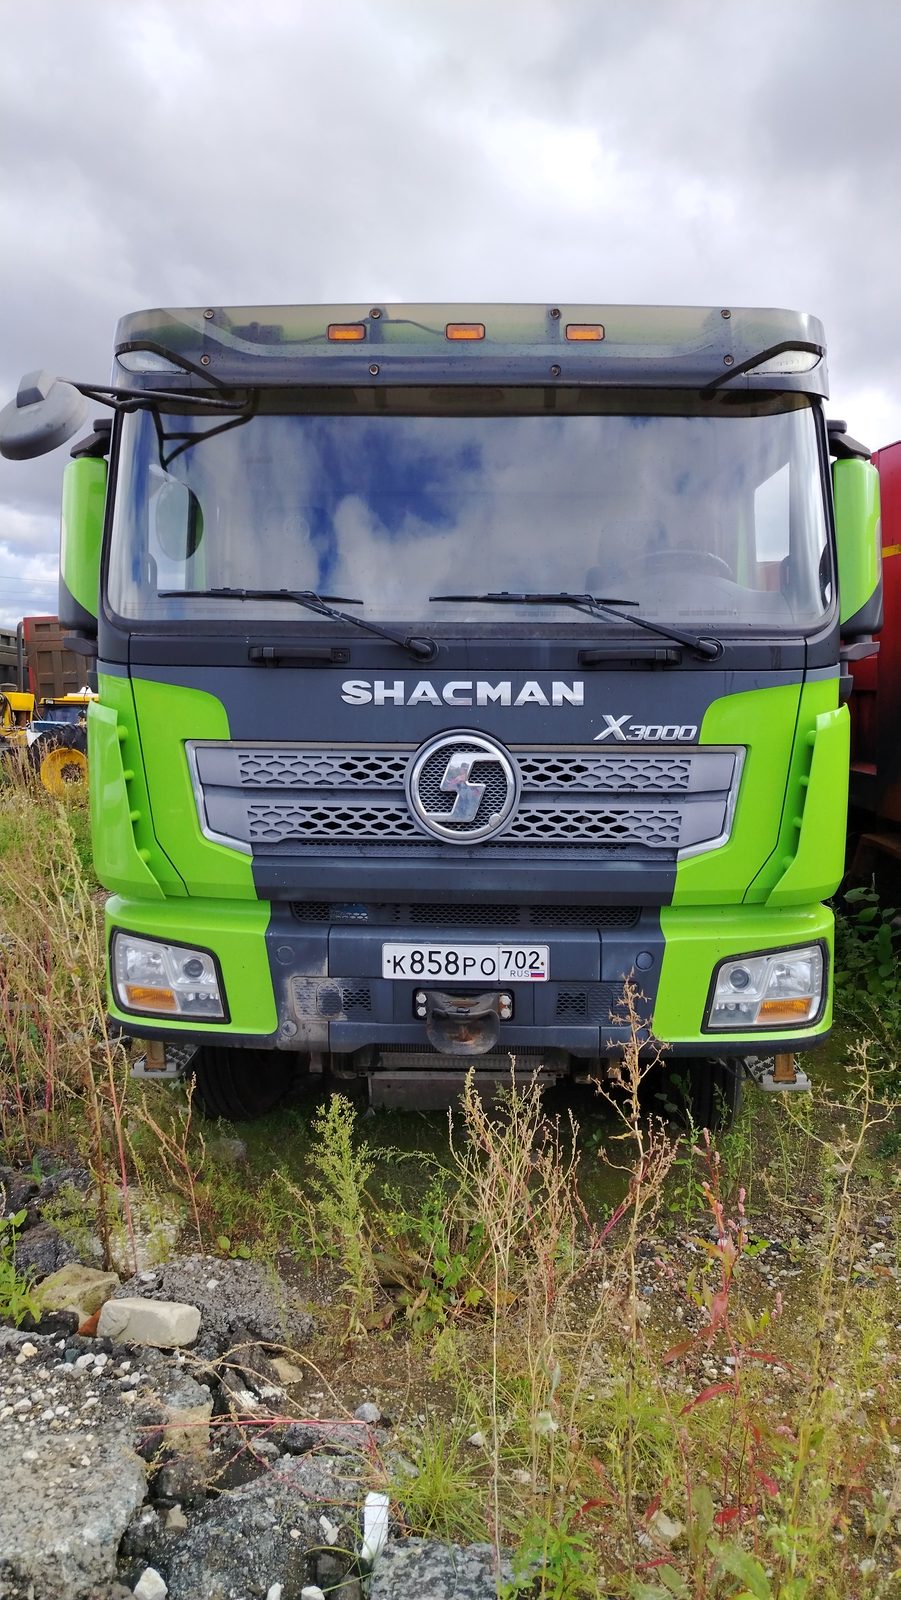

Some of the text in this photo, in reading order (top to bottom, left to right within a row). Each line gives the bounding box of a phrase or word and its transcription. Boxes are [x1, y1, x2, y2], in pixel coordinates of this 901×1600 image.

[341, 680, 585, 706] SHACMAN
[594, 715, 698, 741] X3000
[502, 951, 540, 970] 702
[509, 970, 530, 978] RUS
